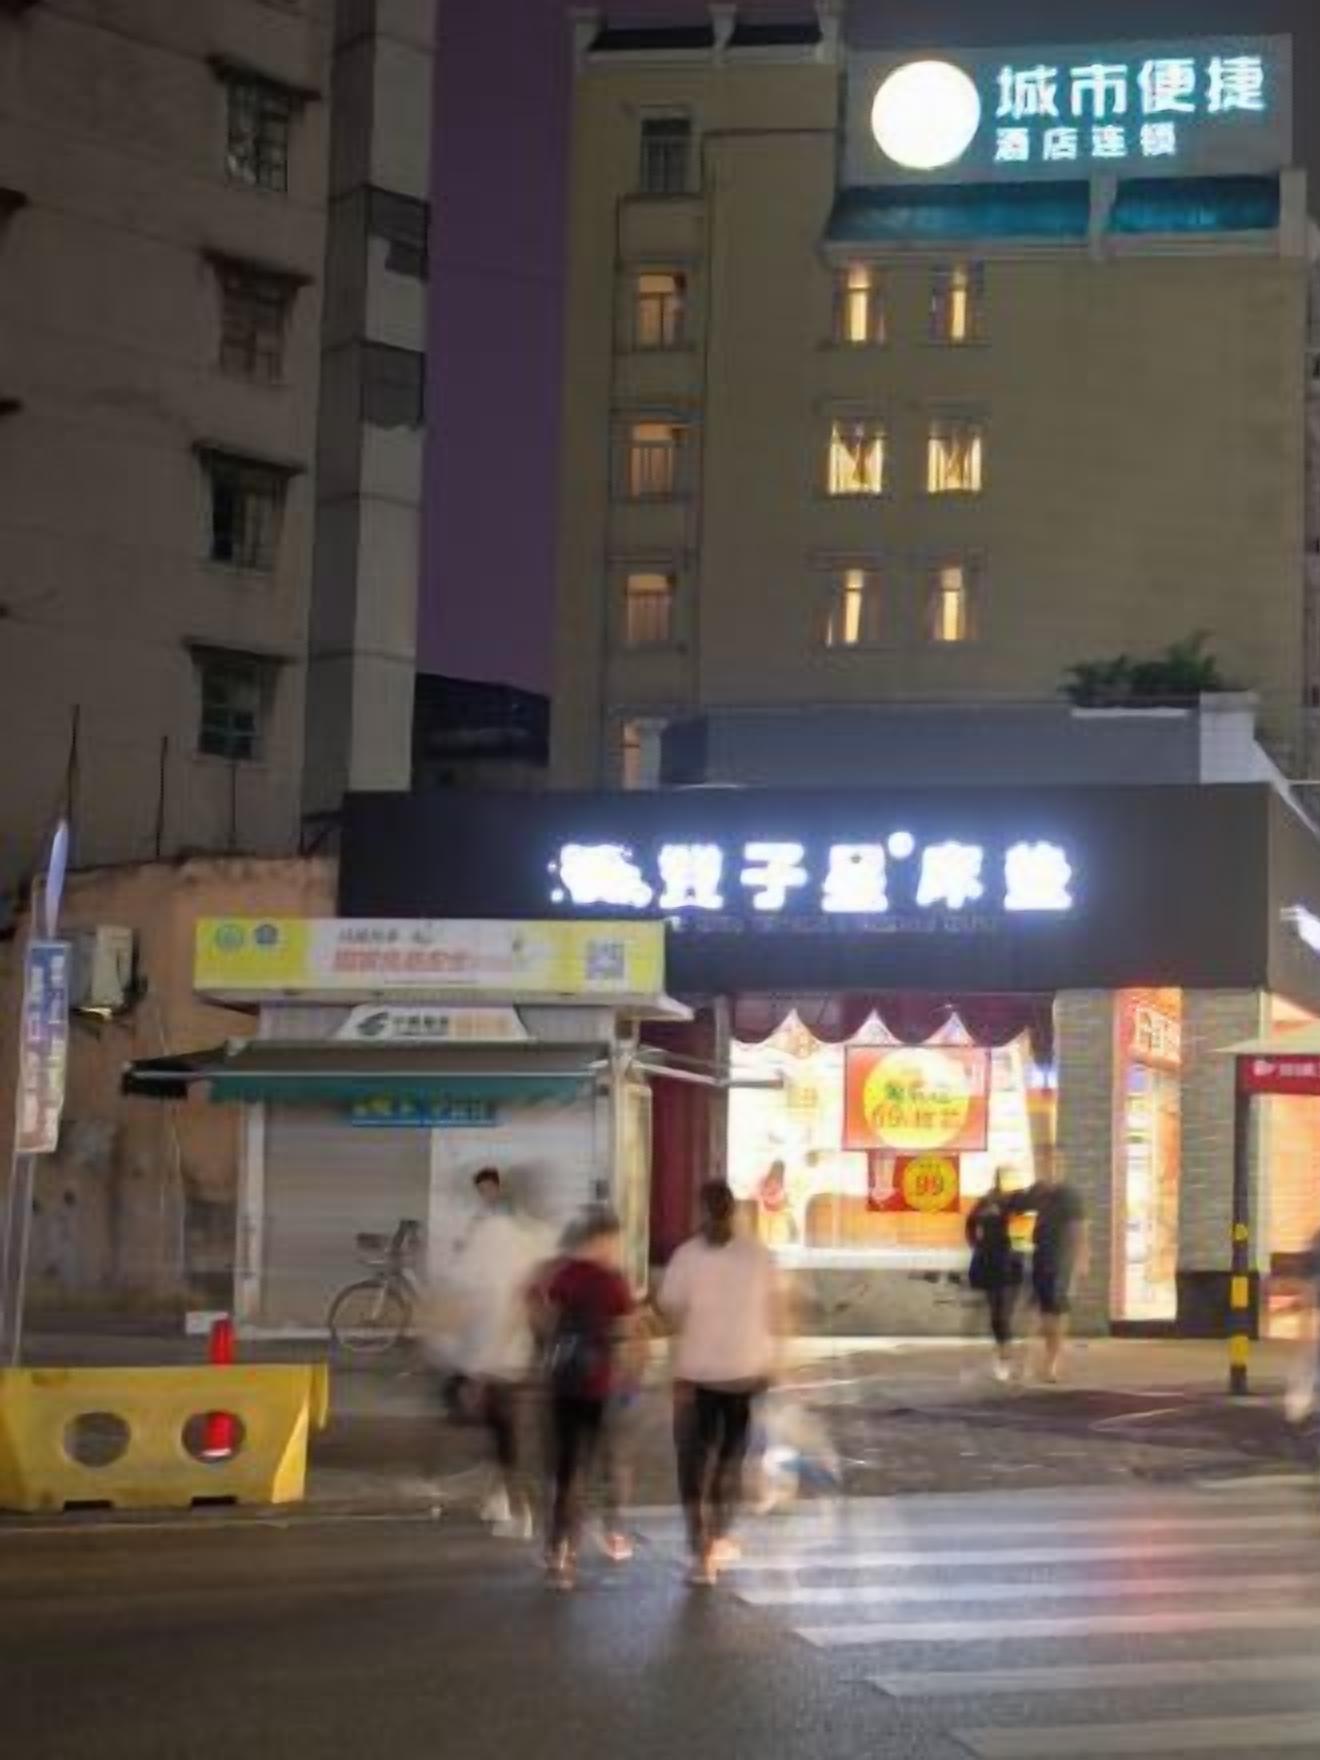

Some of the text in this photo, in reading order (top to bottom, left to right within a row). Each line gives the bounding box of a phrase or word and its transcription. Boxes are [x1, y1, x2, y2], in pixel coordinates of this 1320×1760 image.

[995, 55, 1266, 119] 城市便捷
[994, 122, 1177, 162] 酒店连锁
